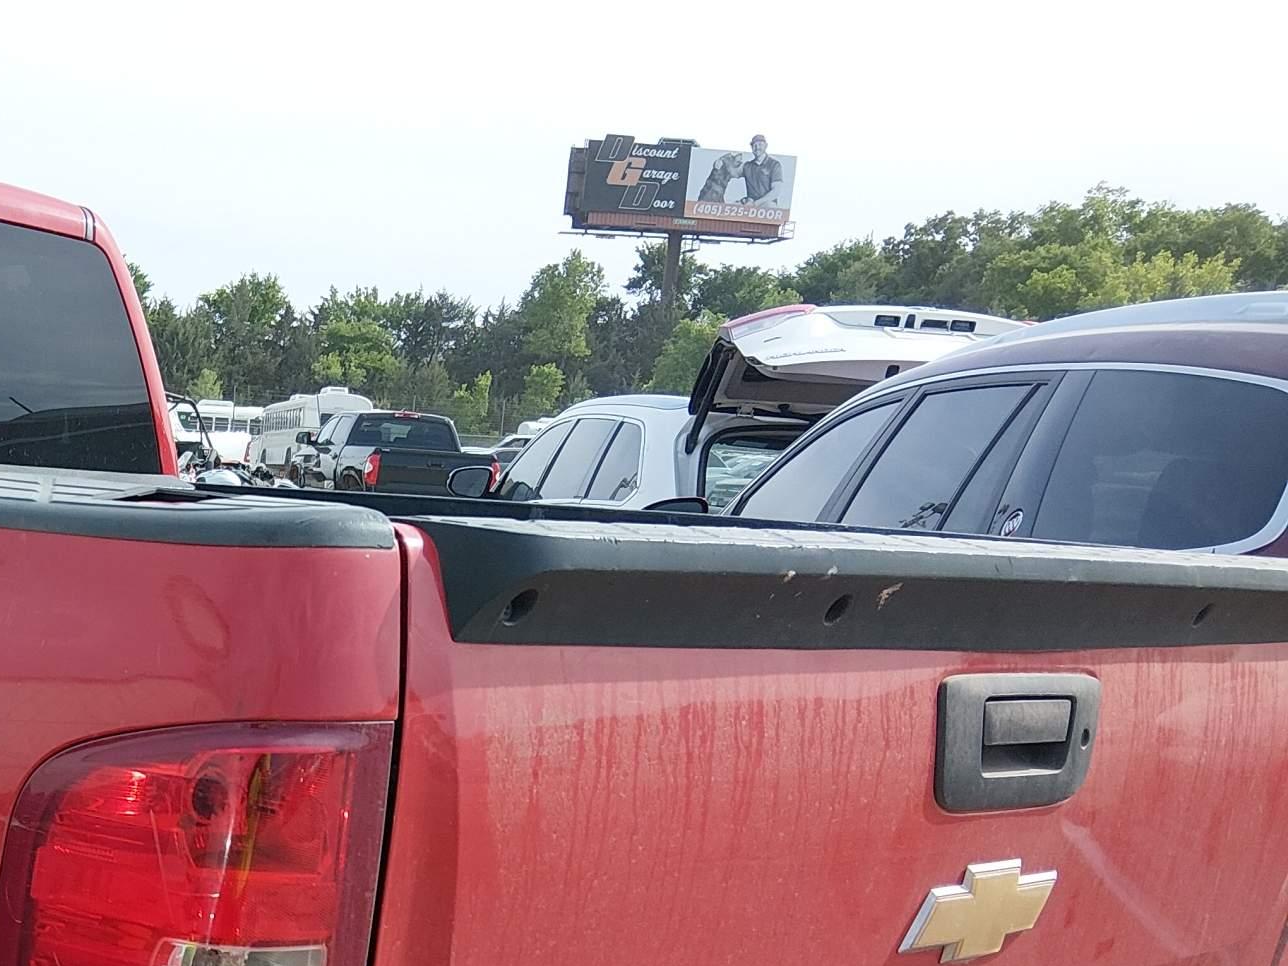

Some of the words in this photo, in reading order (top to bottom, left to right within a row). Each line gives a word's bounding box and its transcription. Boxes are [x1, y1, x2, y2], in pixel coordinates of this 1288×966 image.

[595, 134, 679, 163] Discount
[606, 157, 680, 186] Garage
[618, 181, 675, 210] Door
[693, 201, 722, 217] (405)
[724, 206, 783, 220] 525-DOOR
